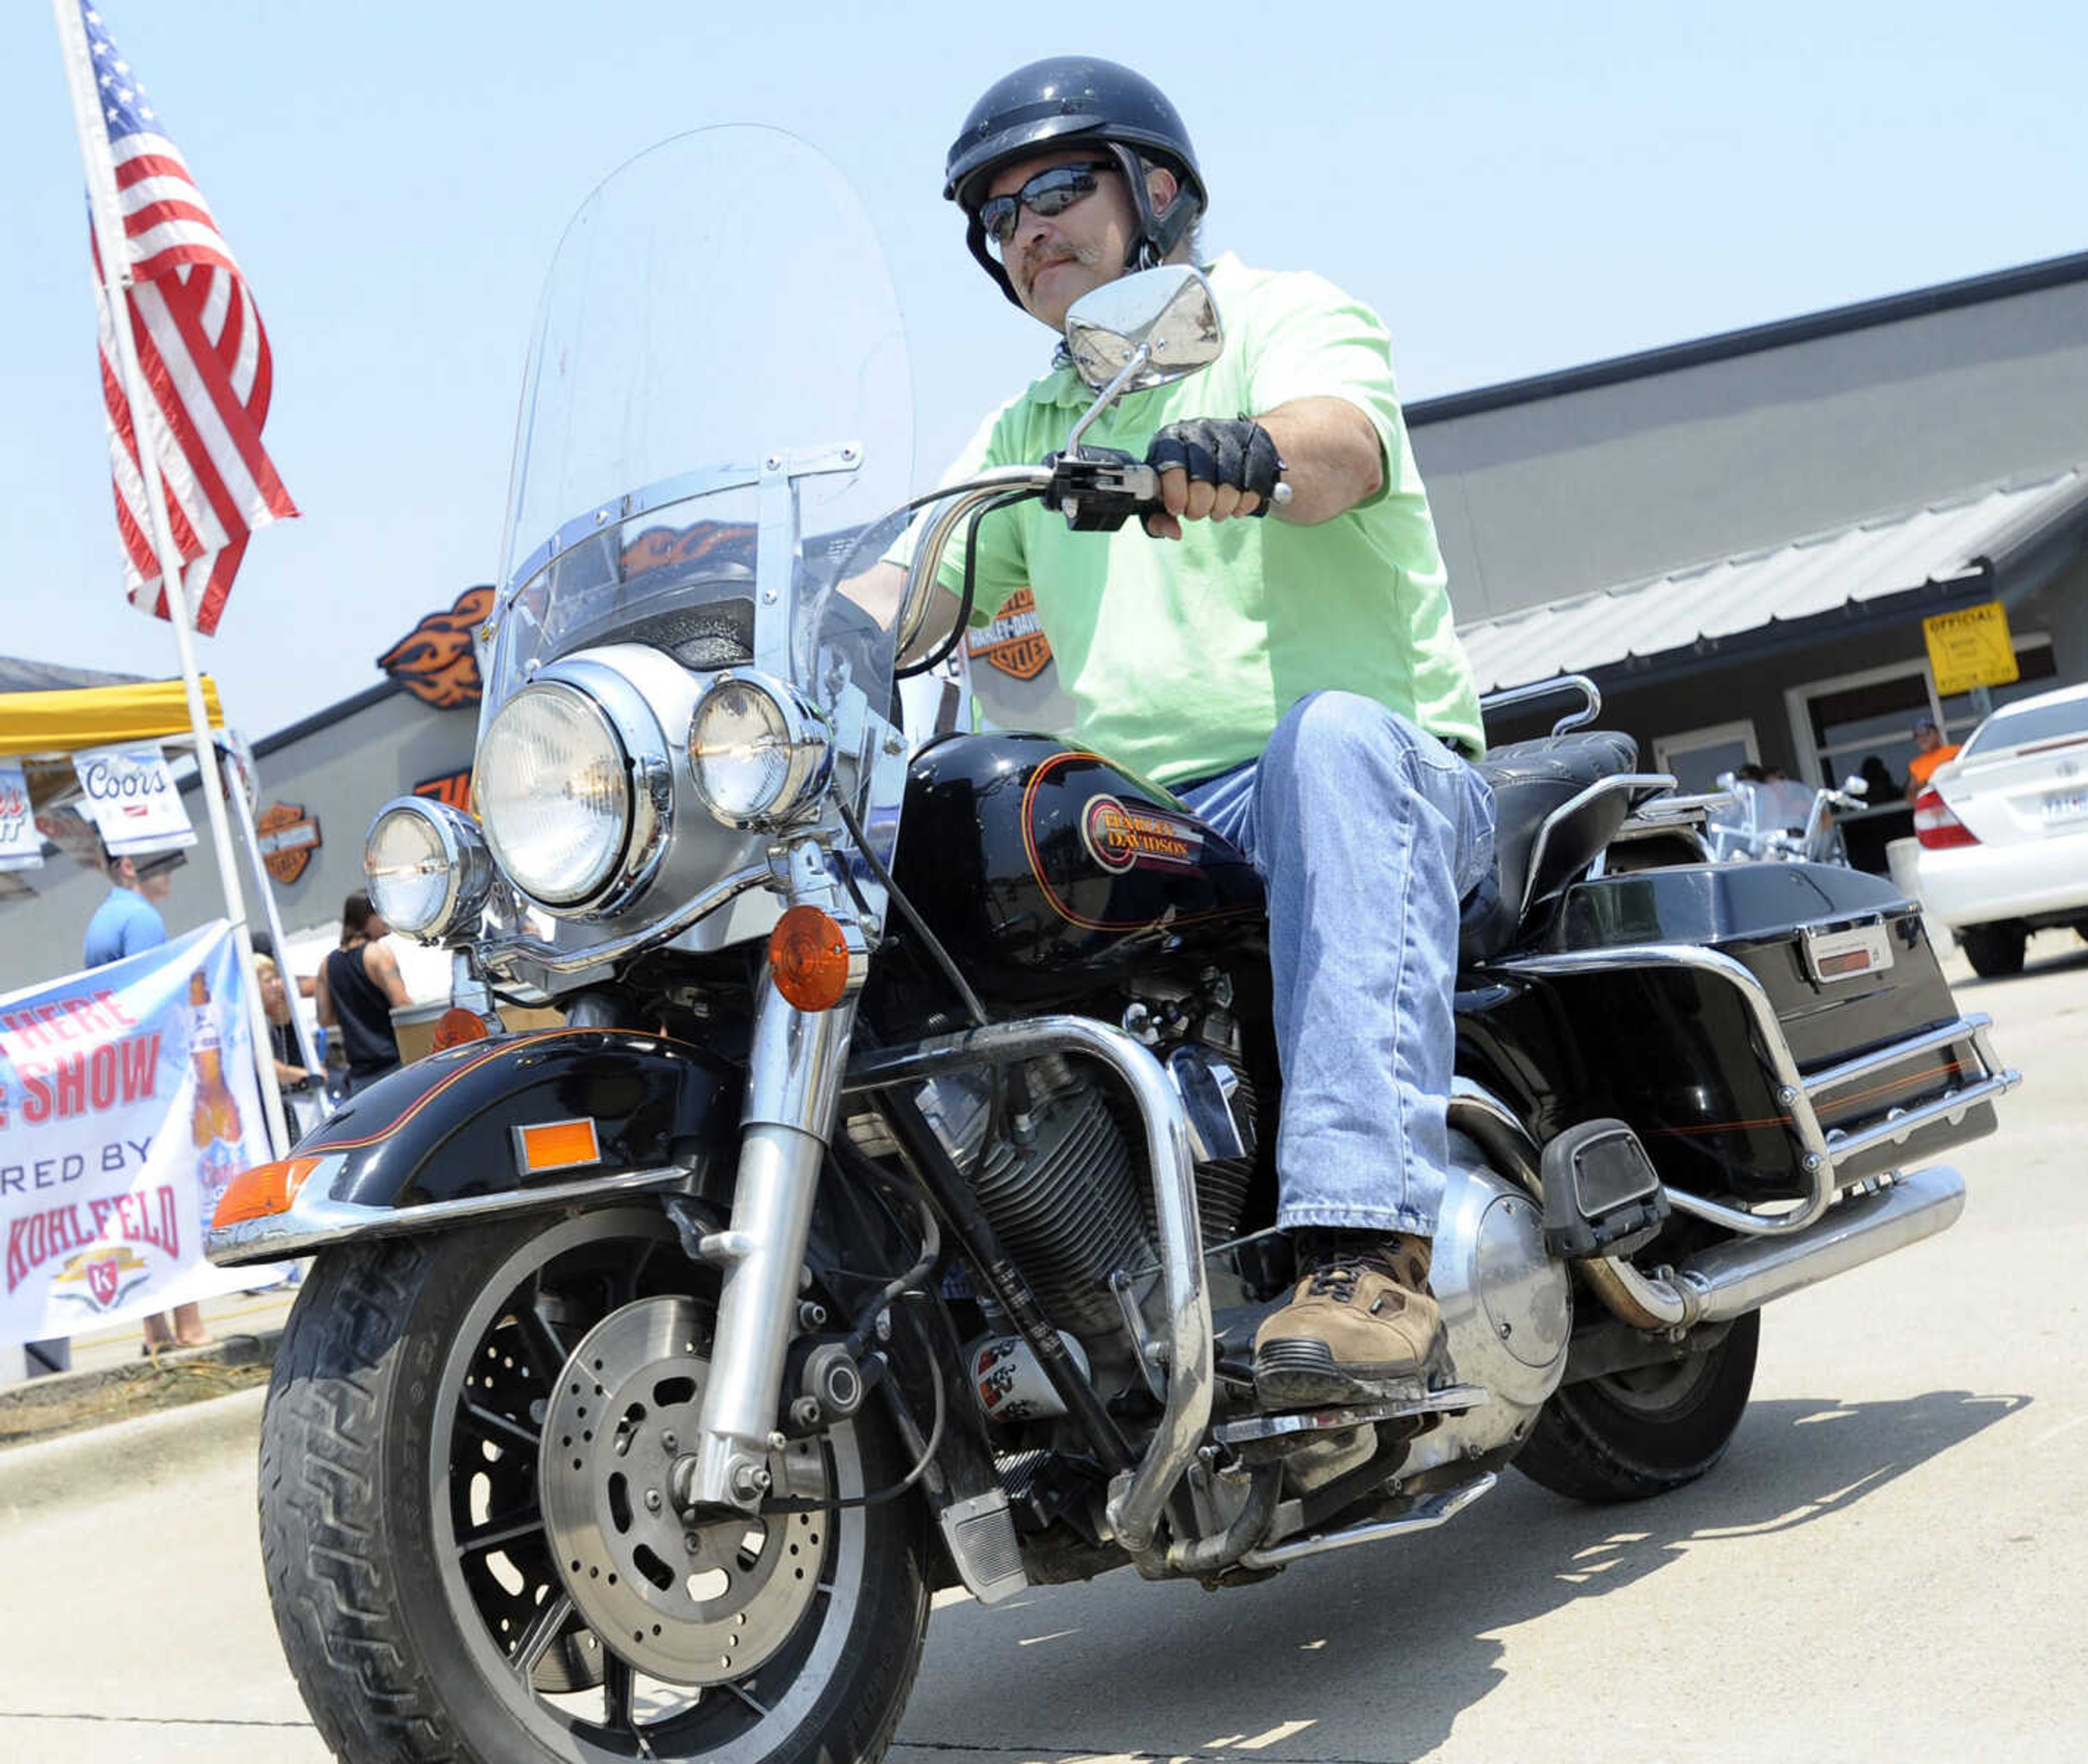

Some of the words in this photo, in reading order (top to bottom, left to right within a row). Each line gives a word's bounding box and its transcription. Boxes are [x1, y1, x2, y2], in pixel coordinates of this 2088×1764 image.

[1930, 607, 1993, 635] OFFICIAL
[86, 763, 166, 799] Coors
[1104, 813, 1174, 836] HARLEY
[1108, 831, 1188, 859] DAVIDSON
[2, 989, 140, 1051] HERE
[16, 1032, 161, 1124] SHOW
[101, 1136, 152, 1172] BY
[6, 1184, 179, 1295] KOHLFELD
